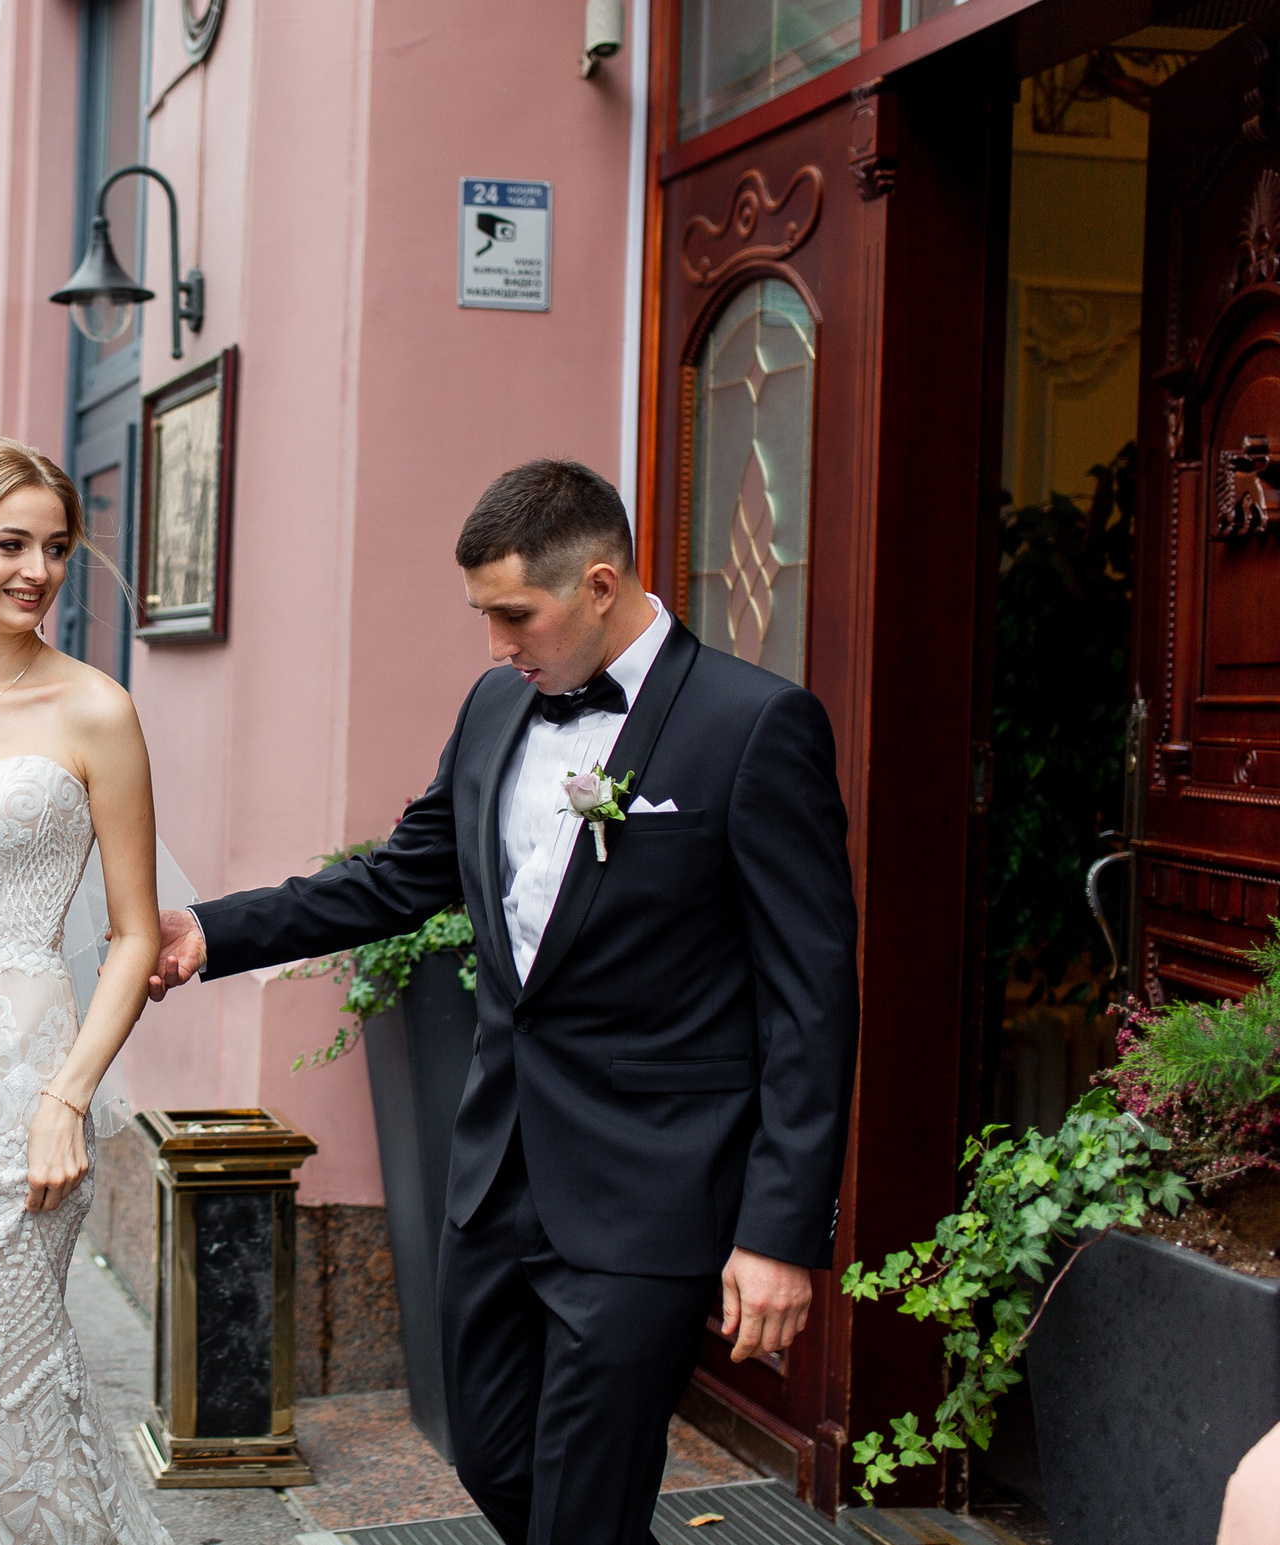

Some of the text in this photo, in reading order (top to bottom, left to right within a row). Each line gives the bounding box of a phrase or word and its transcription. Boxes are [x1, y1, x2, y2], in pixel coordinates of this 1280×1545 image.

[473, 183, 542, 205] 24 HOURS
[515, 259, 542, 267] VIDEO
[473, 266, 542, 276] SURVEILLANCE
[503, 278, 542, 287] ВИДЕО
[466, 288, 542, 299] НАБЛЮДЕНИЕ
